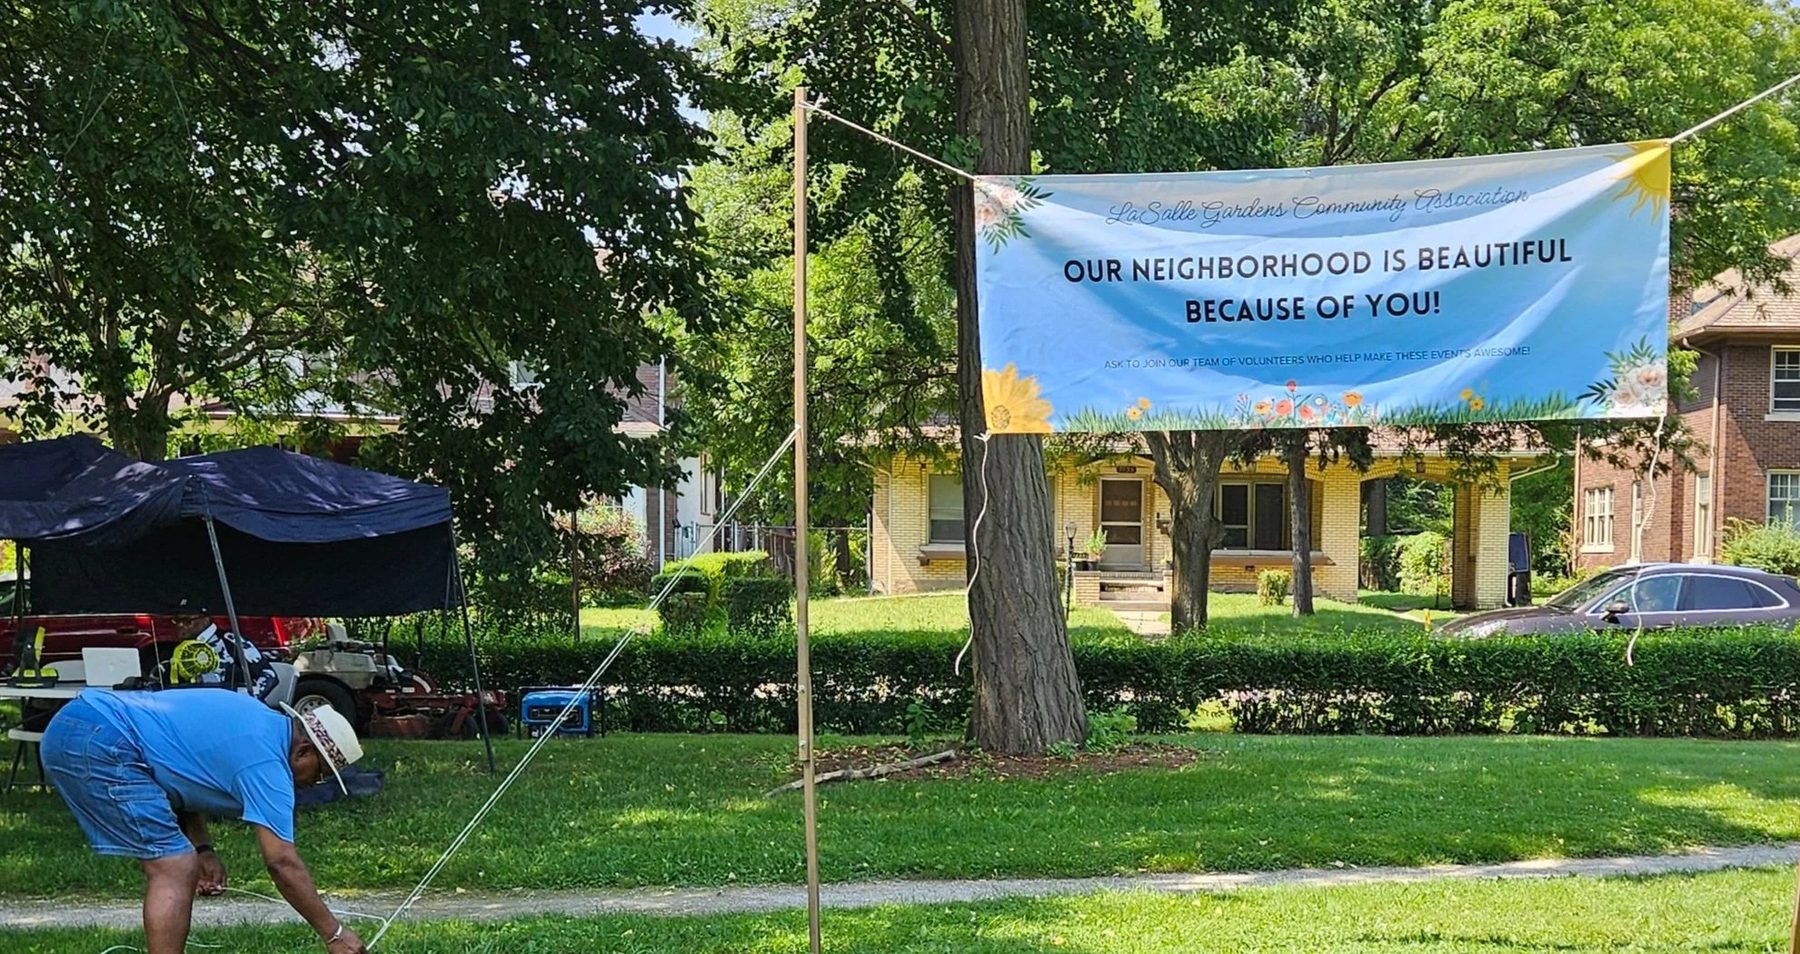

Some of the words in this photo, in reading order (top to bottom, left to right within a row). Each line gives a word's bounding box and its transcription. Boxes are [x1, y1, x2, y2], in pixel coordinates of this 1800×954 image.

[1105, 200, 1199, 225] LaSalle
[1200, 197, 1288, 228] Gardens
[1292, 194, 1408, 223] Community
[1414, 187, 1529, 213] Association
[1064, 258, 1122, 282] OUR
[1132, 251, 1371, 281] NEIGHBORHOOD
[1384, 249, 1406, 272] IS
[1418, 238, 1572, 271] BEAUTIFUL
[1186, 297, 1306, 323] BECAUSE
[1316, 295, 1354, 319] OF
[1364, 290, 1440, 317] YOU!
[1104, 359, 1124, 369] ASK
[1127, 359, 1140, 368] TO
[1142, 358, 1166, 368] JOIN
[1168, 358, 1189, 368] OUR
[1193, 357, 1220, 367] TEAM
[1222, 357, 1237, 367] OF
[1239, 355, 1304, 366] VOLUNTEERS
[1307, 354, 1332, 364] WHO
[1335, 353, 1361, 363] HELP
[1363, 352, 1392, 361] MAKE
[1396, 351, 1428, 360] THESE
[1431, 348, 1472, 359] EVENTS
[1474, 346, 1530, 358] AWESOME!
